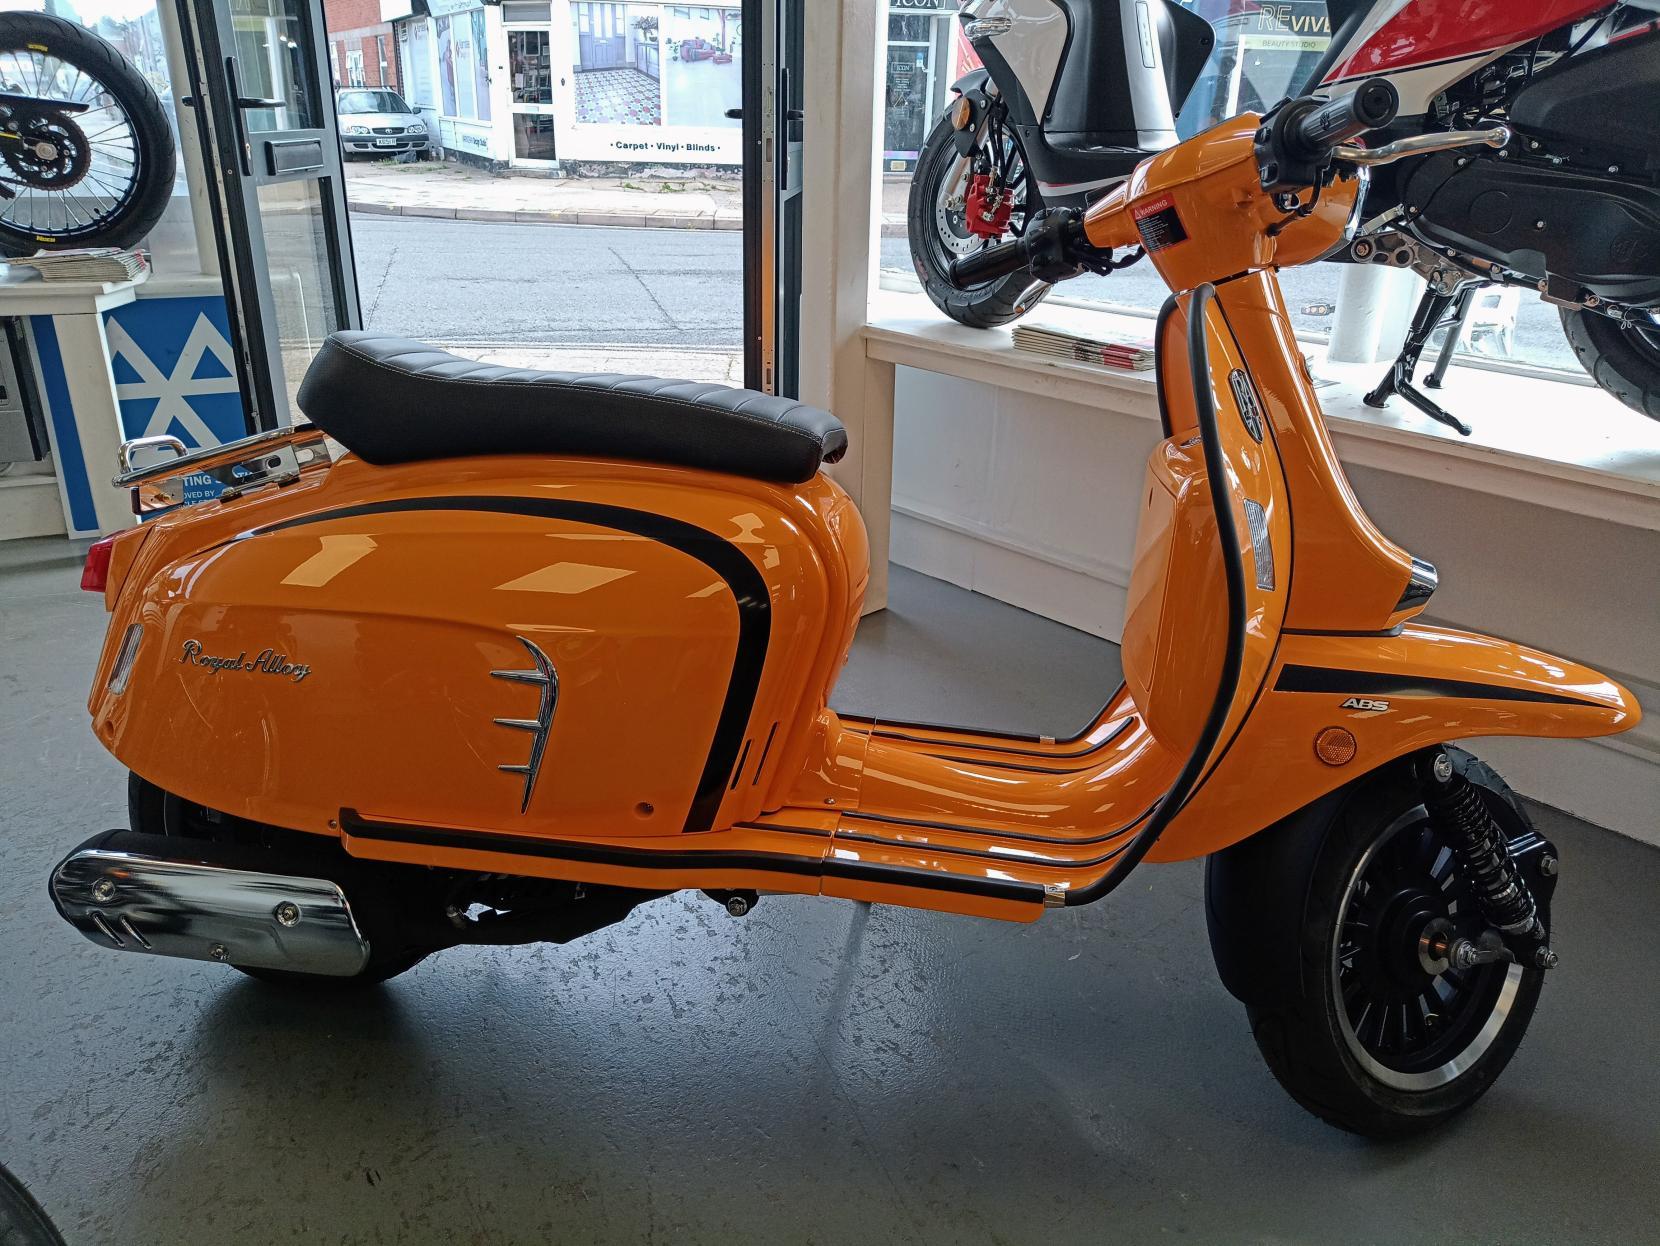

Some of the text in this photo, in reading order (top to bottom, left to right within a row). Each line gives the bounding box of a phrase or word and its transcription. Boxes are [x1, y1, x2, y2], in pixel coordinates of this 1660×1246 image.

[1262, 40, 1289, 48] BEAUTY
[615, 141, 715, 152] Carpet Vinyl Blinds
[1141, 199, 1168, 216] WARNING
[178, 639, 312, 682] Royal Alloy
[1341, 698, 1390, 711] ABS
